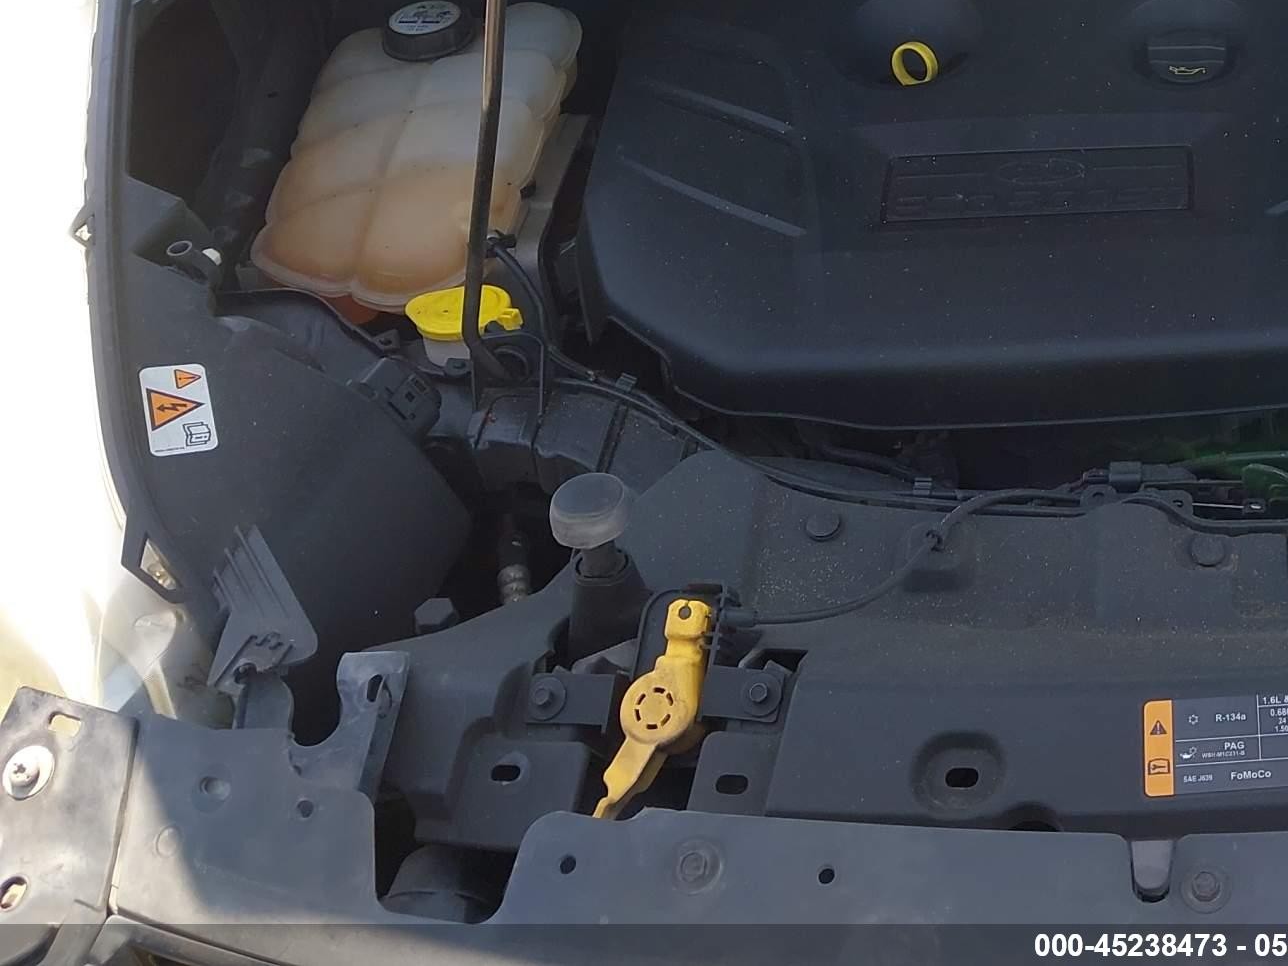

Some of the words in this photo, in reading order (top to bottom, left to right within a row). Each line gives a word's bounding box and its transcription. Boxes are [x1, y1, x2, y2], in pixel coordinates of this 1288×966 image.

[1262, 695, 1281, 704] 1.6L
[1215, 712, 1247, 722] R-134a
[1224, 741, 1245, 750] PAG
[1183, 775, 1197, 783] SAE
[1230, 769, 1272, 780] FoMoCo
